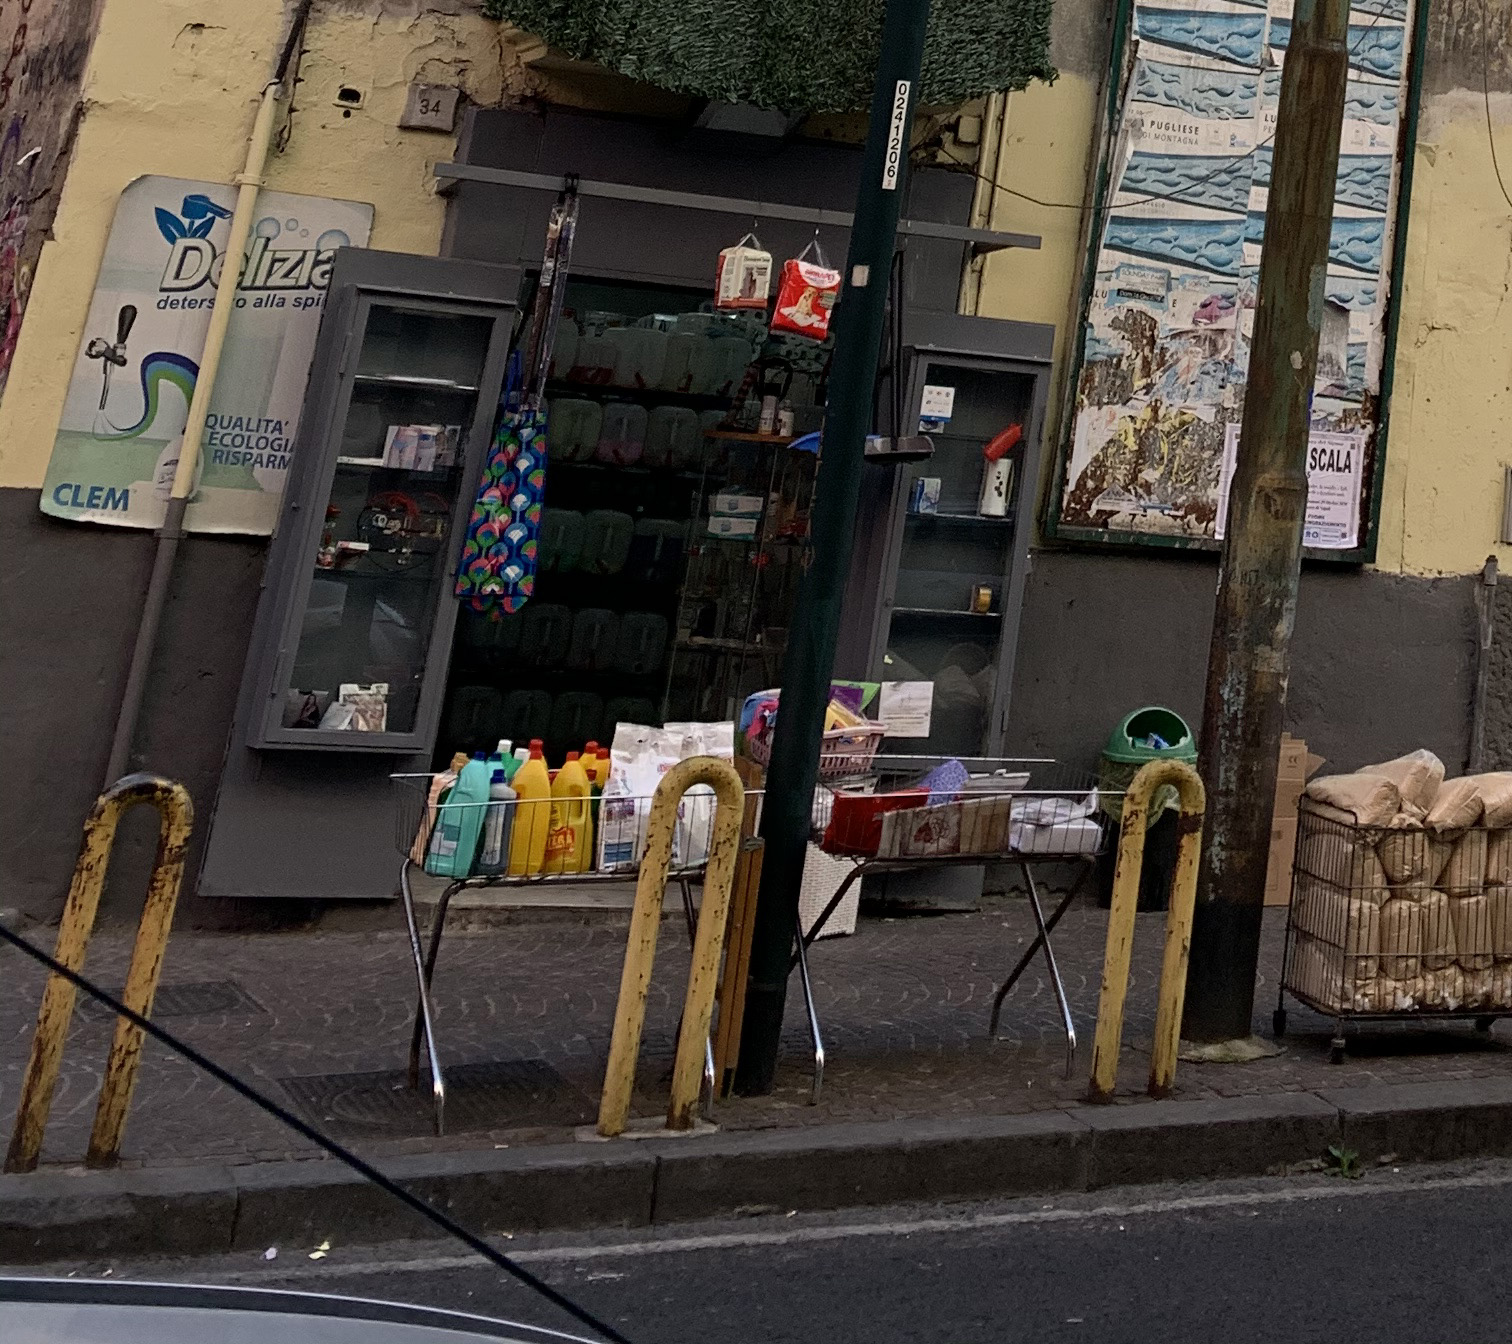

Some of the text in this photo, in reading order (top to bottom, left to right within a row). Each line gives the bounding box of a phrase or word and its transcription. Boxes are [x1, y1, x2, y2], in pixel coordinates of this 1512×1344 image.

[419, 98, 441, 117] 34
[1150, 119, 1199, 135] PUGLIESE
[1154, 132, 1199, 145] MONTAGNA
[156, 294, 327, 313] deterso alla spi
[207, 431, 294, 453] ECOLOGI
[212, 449, 293, 470] RISPARM
[1309, 446, 1352, 474] SCALA
[52, 482, 130, 512] CLEM
